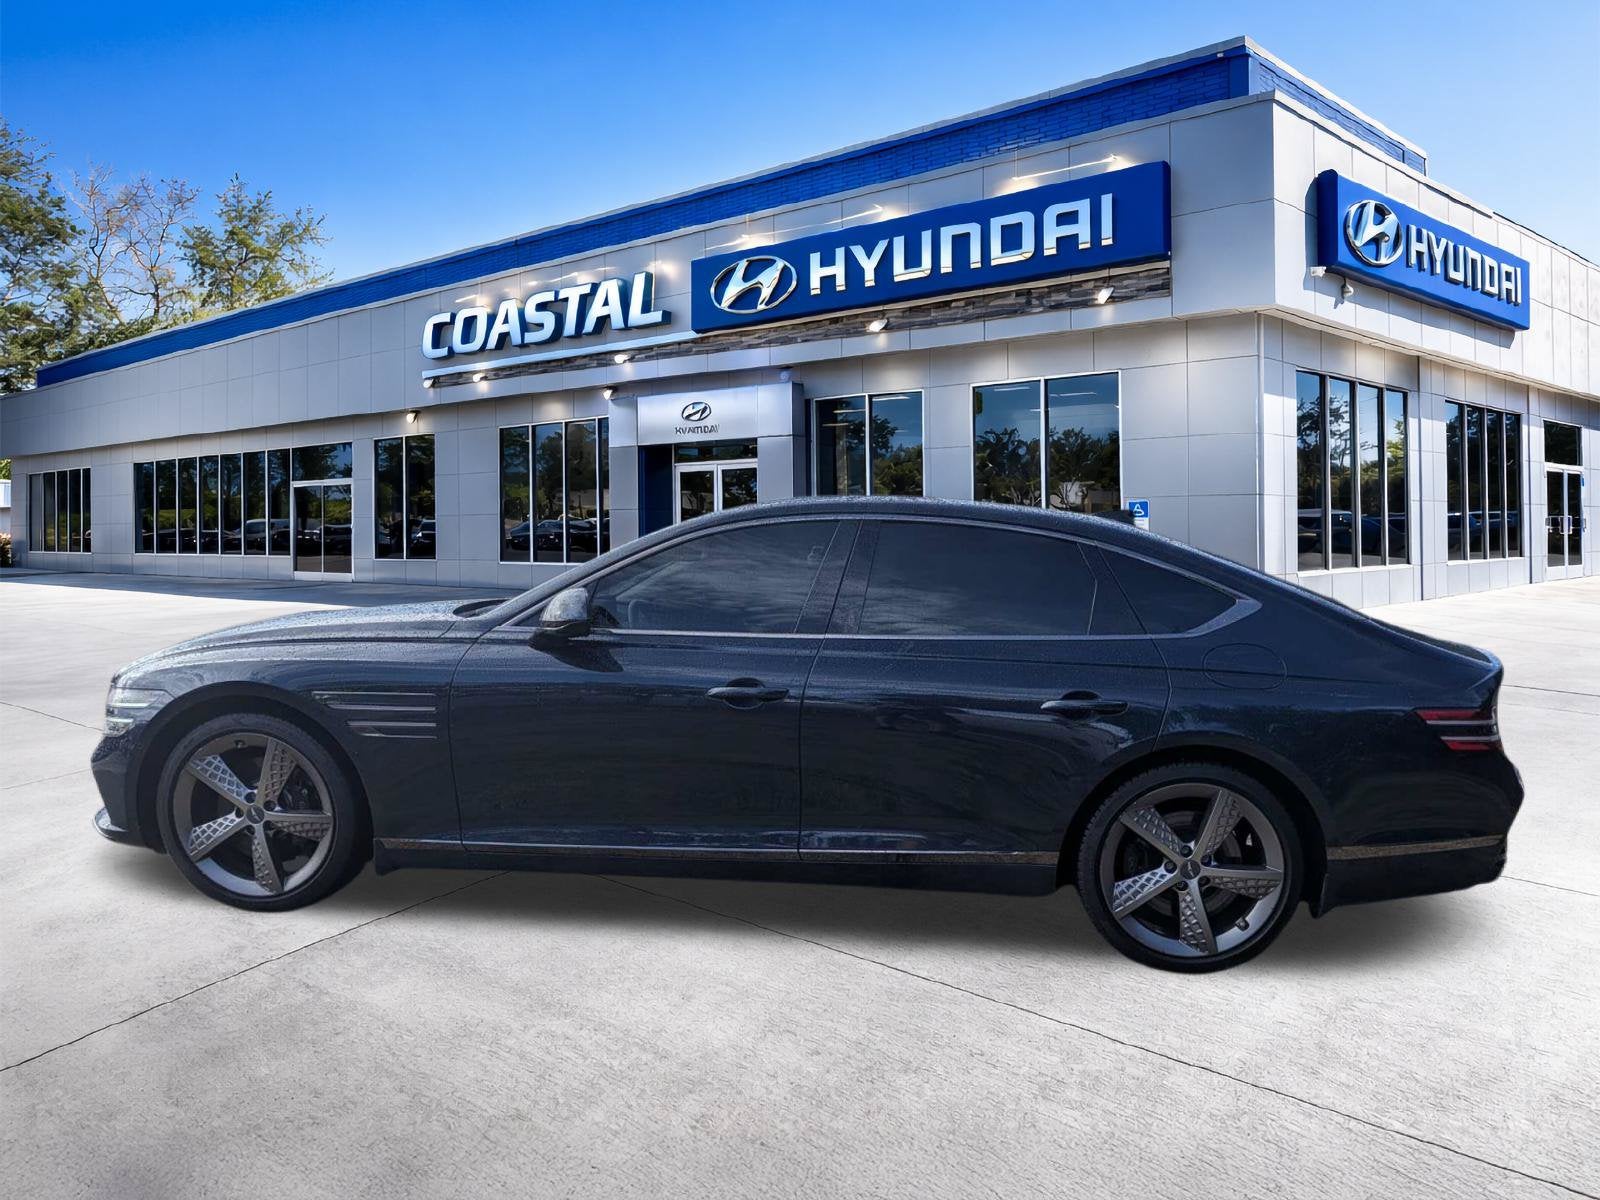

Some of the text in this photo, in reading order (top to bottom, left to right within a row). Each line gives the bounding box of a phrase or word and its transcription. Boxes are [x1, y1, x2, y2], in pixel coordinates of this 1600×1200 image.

[809, 192, 1114, 296] HYUNDAI
[1406, 224, 1522, 306] HYUNDAI
[421, 271, 671, 360] COASTAL
